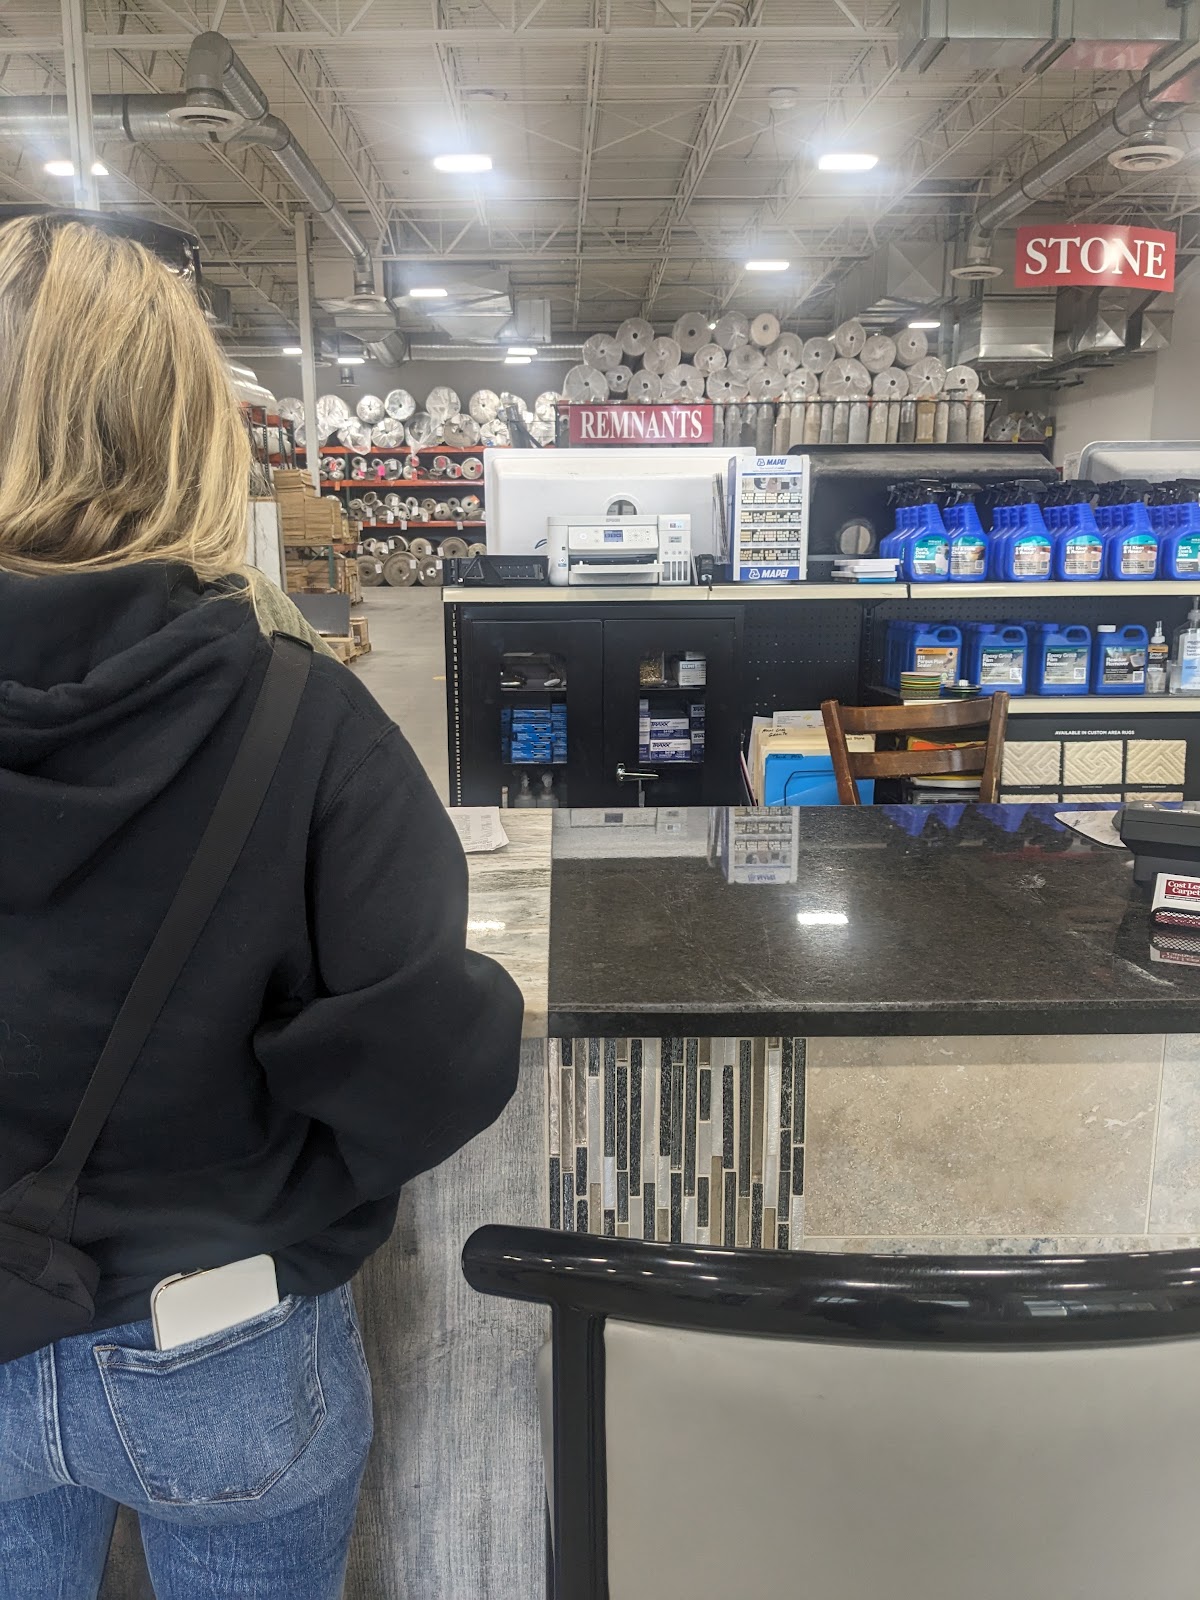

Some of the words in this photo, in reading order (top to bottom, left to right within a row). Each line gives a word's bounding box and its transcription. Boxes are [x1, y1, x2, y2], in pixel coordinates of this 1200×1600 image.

[1025, 236, 1166, 279] STONE
[580, 409, 703, 439] REMNANTS
[761, 569, 789, 578] MAPEI
